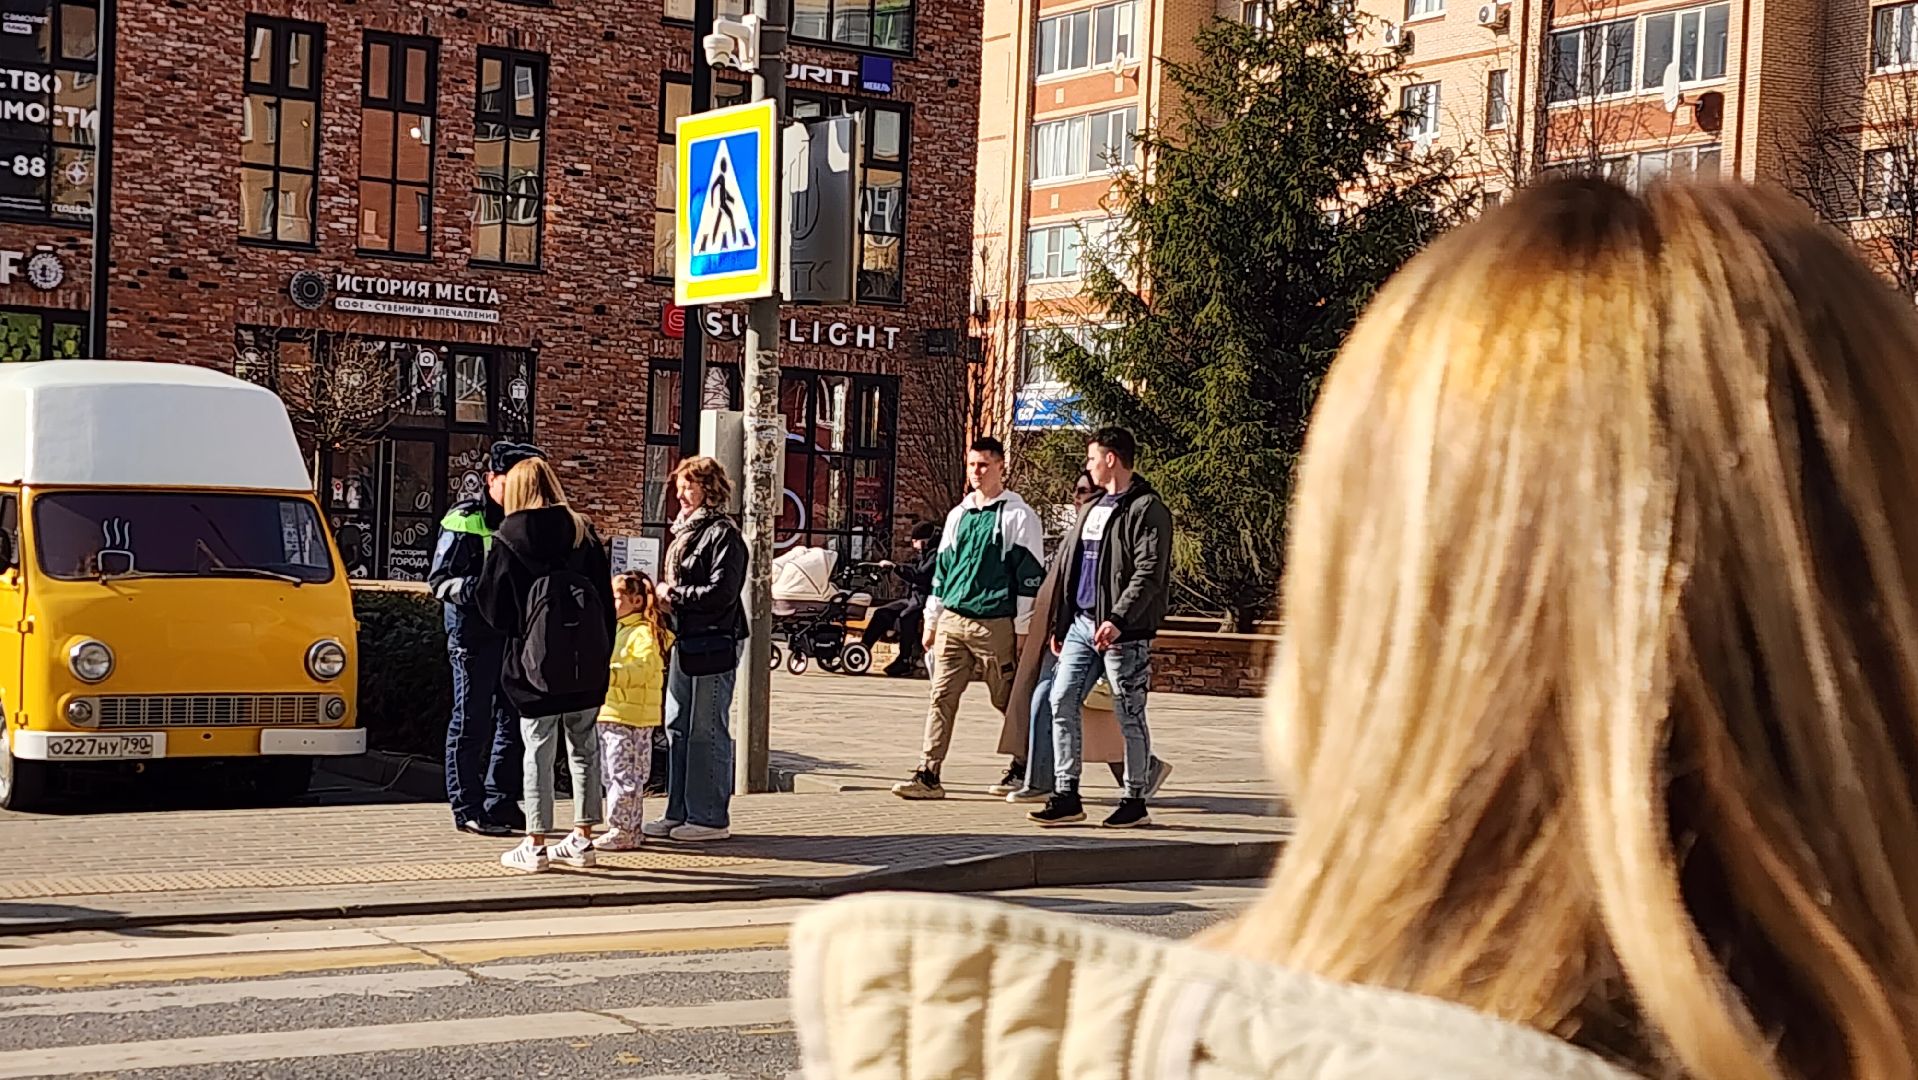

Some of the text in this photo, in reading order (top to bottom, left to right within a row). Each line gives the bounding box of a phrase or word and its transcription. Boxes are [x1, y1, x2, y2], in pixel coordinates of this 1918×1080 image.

[0, 100, 98, 129] МОСТИ
[336, 274, 500, 305] ИСТОРИЯ МЕСТА
[337, 300, 498, 321] КОФЕ СУВЕНИРЫ ВПЕЧАТЛЕНИЯ
[706, 311, 901, 350] SULIGHT
[390, 557, 430, 568] ГОРОДА
